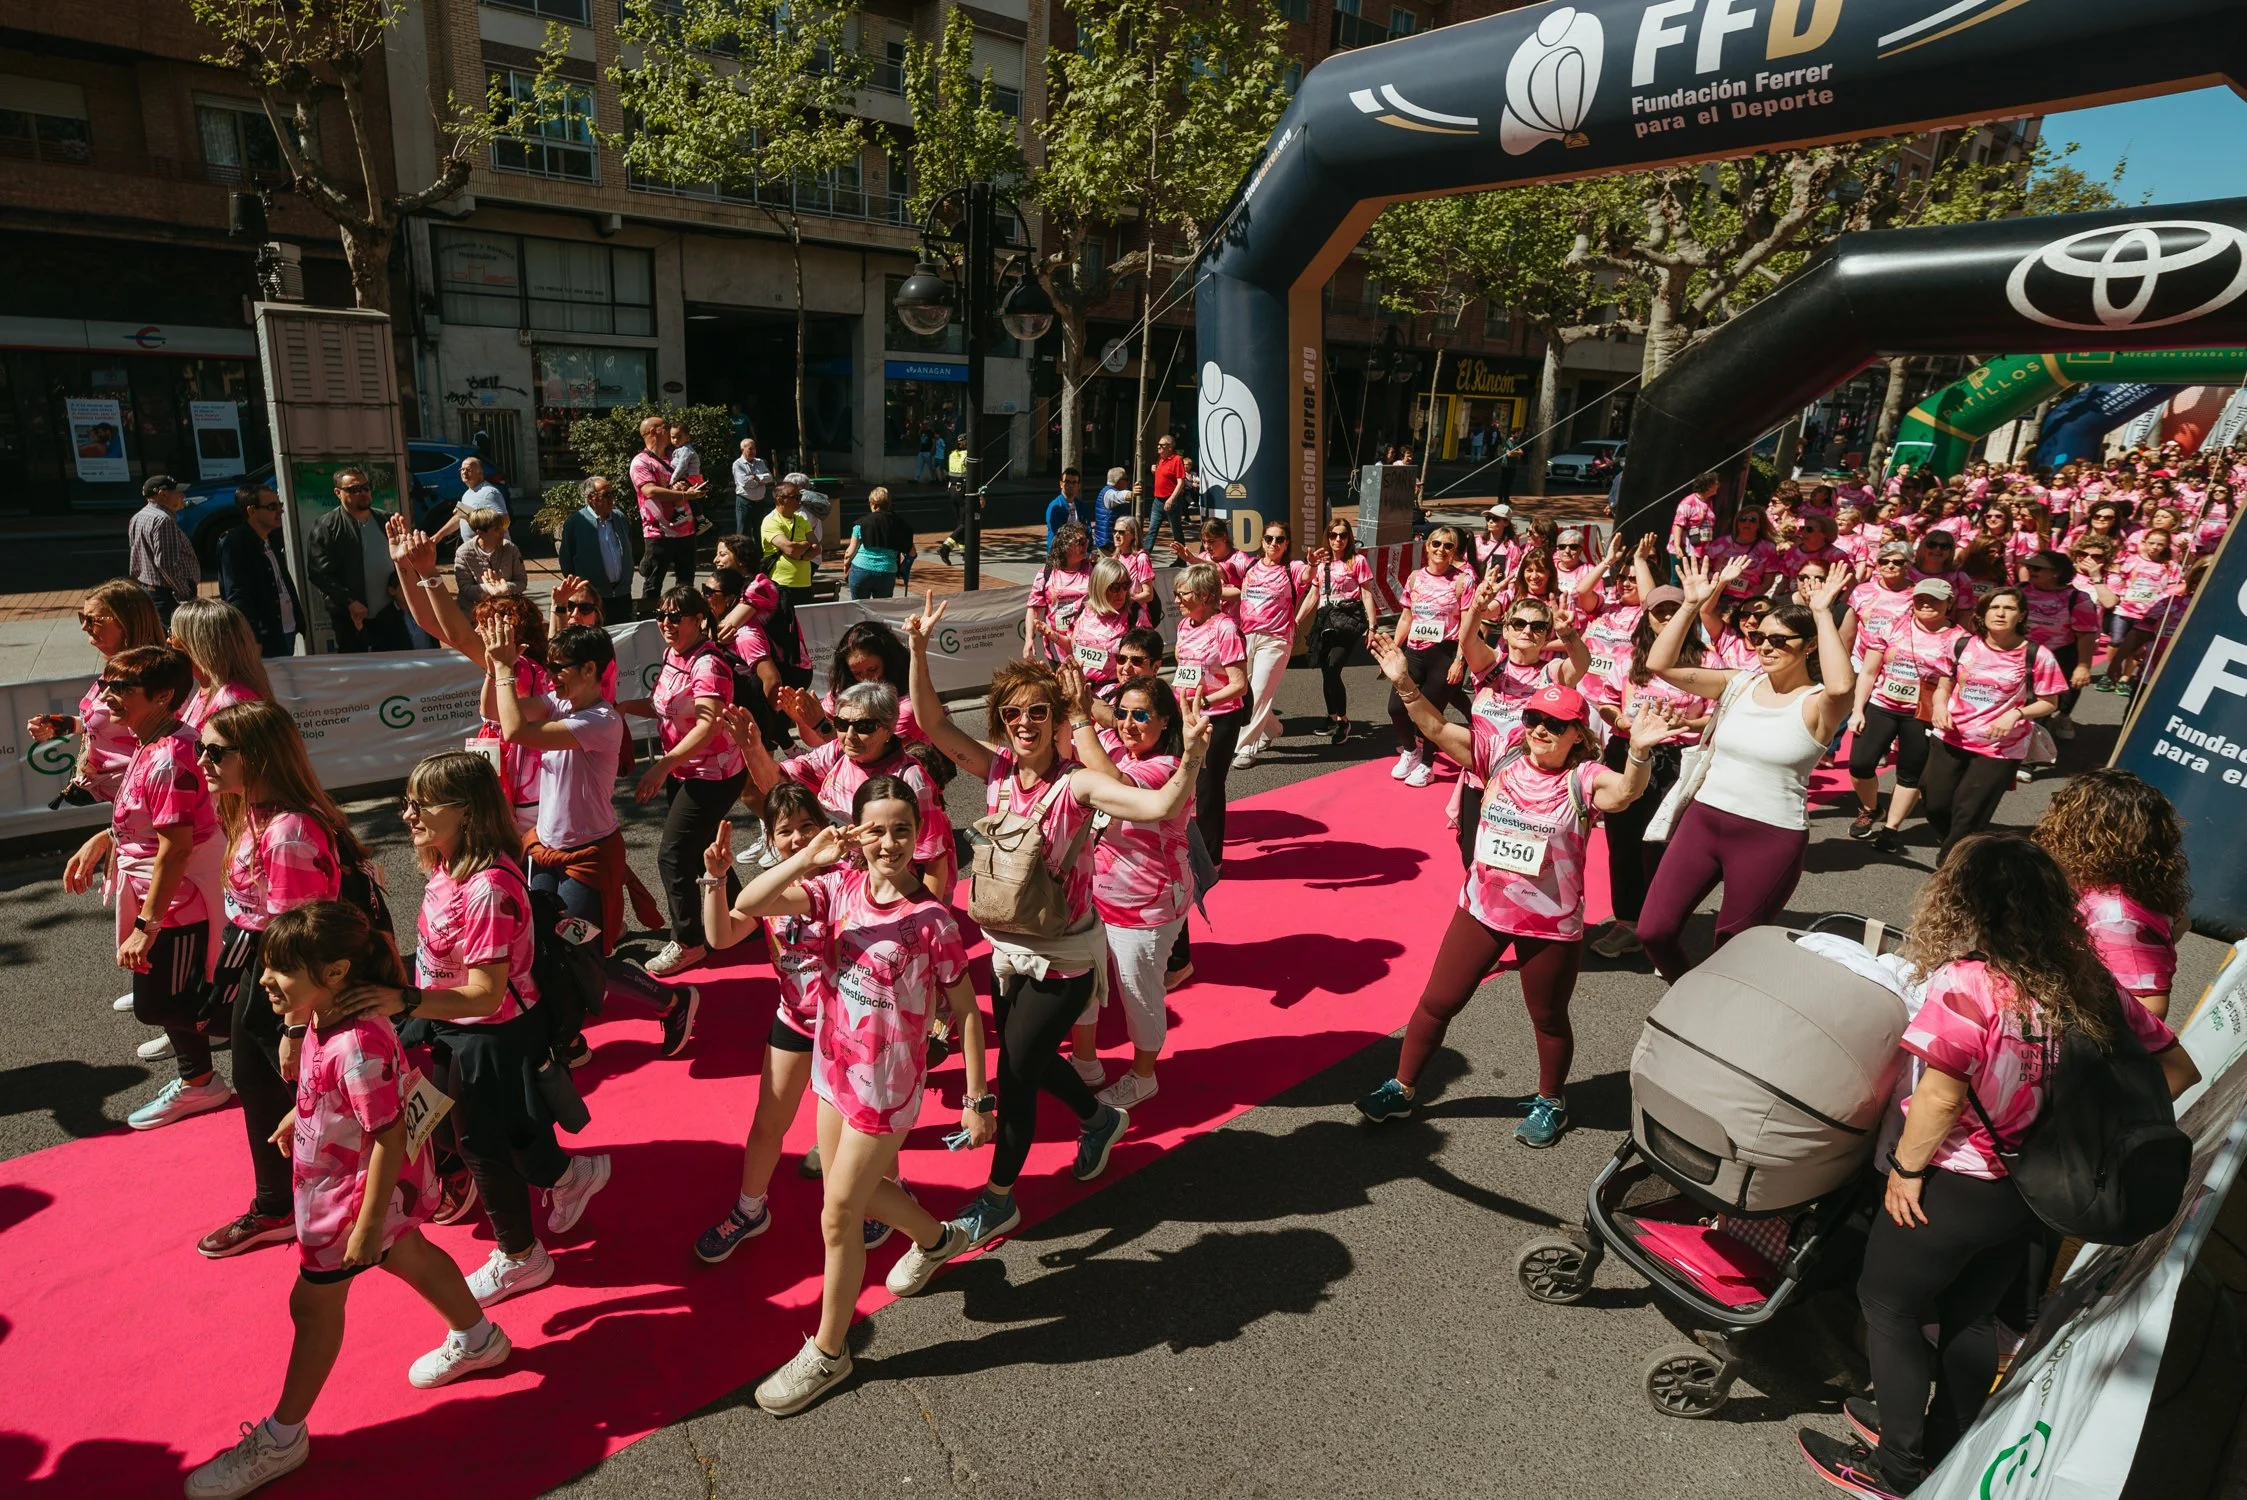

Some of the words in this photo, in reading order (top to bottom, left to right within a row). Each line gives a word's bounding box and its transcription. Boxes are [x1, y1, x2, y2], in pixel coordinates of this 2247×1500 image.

[1631, 0, 1844, 86] FFD
[1631, 79, 1747, 114] Fundación
[1755, 63, 1833, 93] Ferrer
[1634, 115, 1686, 138] para
[1697, 106, 1719, 125] el
[1731, 88, 1834, 119] Deporte
[1456, 358, 1472, 391] El
[1472, 359, 1515, 393] Rincón
[962, 625, 990, 634] asociación
[990, 622, 1013, 632] española
[1414, 625, 1439, 636] 4044
[963, 634, 981, 642] contra
[988, 631, 1005, 639] cáncer
[979, 641, 993, 649] Rioja
[1080, 648, 1102, 662] 9622
[1590, 657, 1613, 670] 6911
[1178, 668, 1196, 681] 9623
[1888, 682, 1917, 696] 6962
[420, 690, 468, 703] asociación
[1633, 692, 1668, 703] Carrea
[292, 707, 321, 719] ación
[323, 703, 370, 716] española
[421, 702, 454, 713] contra
[454, 701, 463, 709] el
[464, 698, 481, 708] cán
[304, 718, 313, 728] el
[315, 716, 351, 728] cáncer
[436, 712, 449, 722] La
[450, 710, 473, 720] Rioja
[2152, 738, 2209, 773] para
[1488, 803, 1506, 812] por
[1506, 808, 1516, 816] la
[1487, 812, 1556, 834] Investigación
[1492, 838, 1534, 863] 1560
[781, 955, 793, 964] por
[794, 955, 801, 964] la
[840, 953, 871, 977] Carrera
[838, 968, 851, 981] por
[851, 973, 859, 987] la
[2210, 1006, 2224, 1031] Rioja
